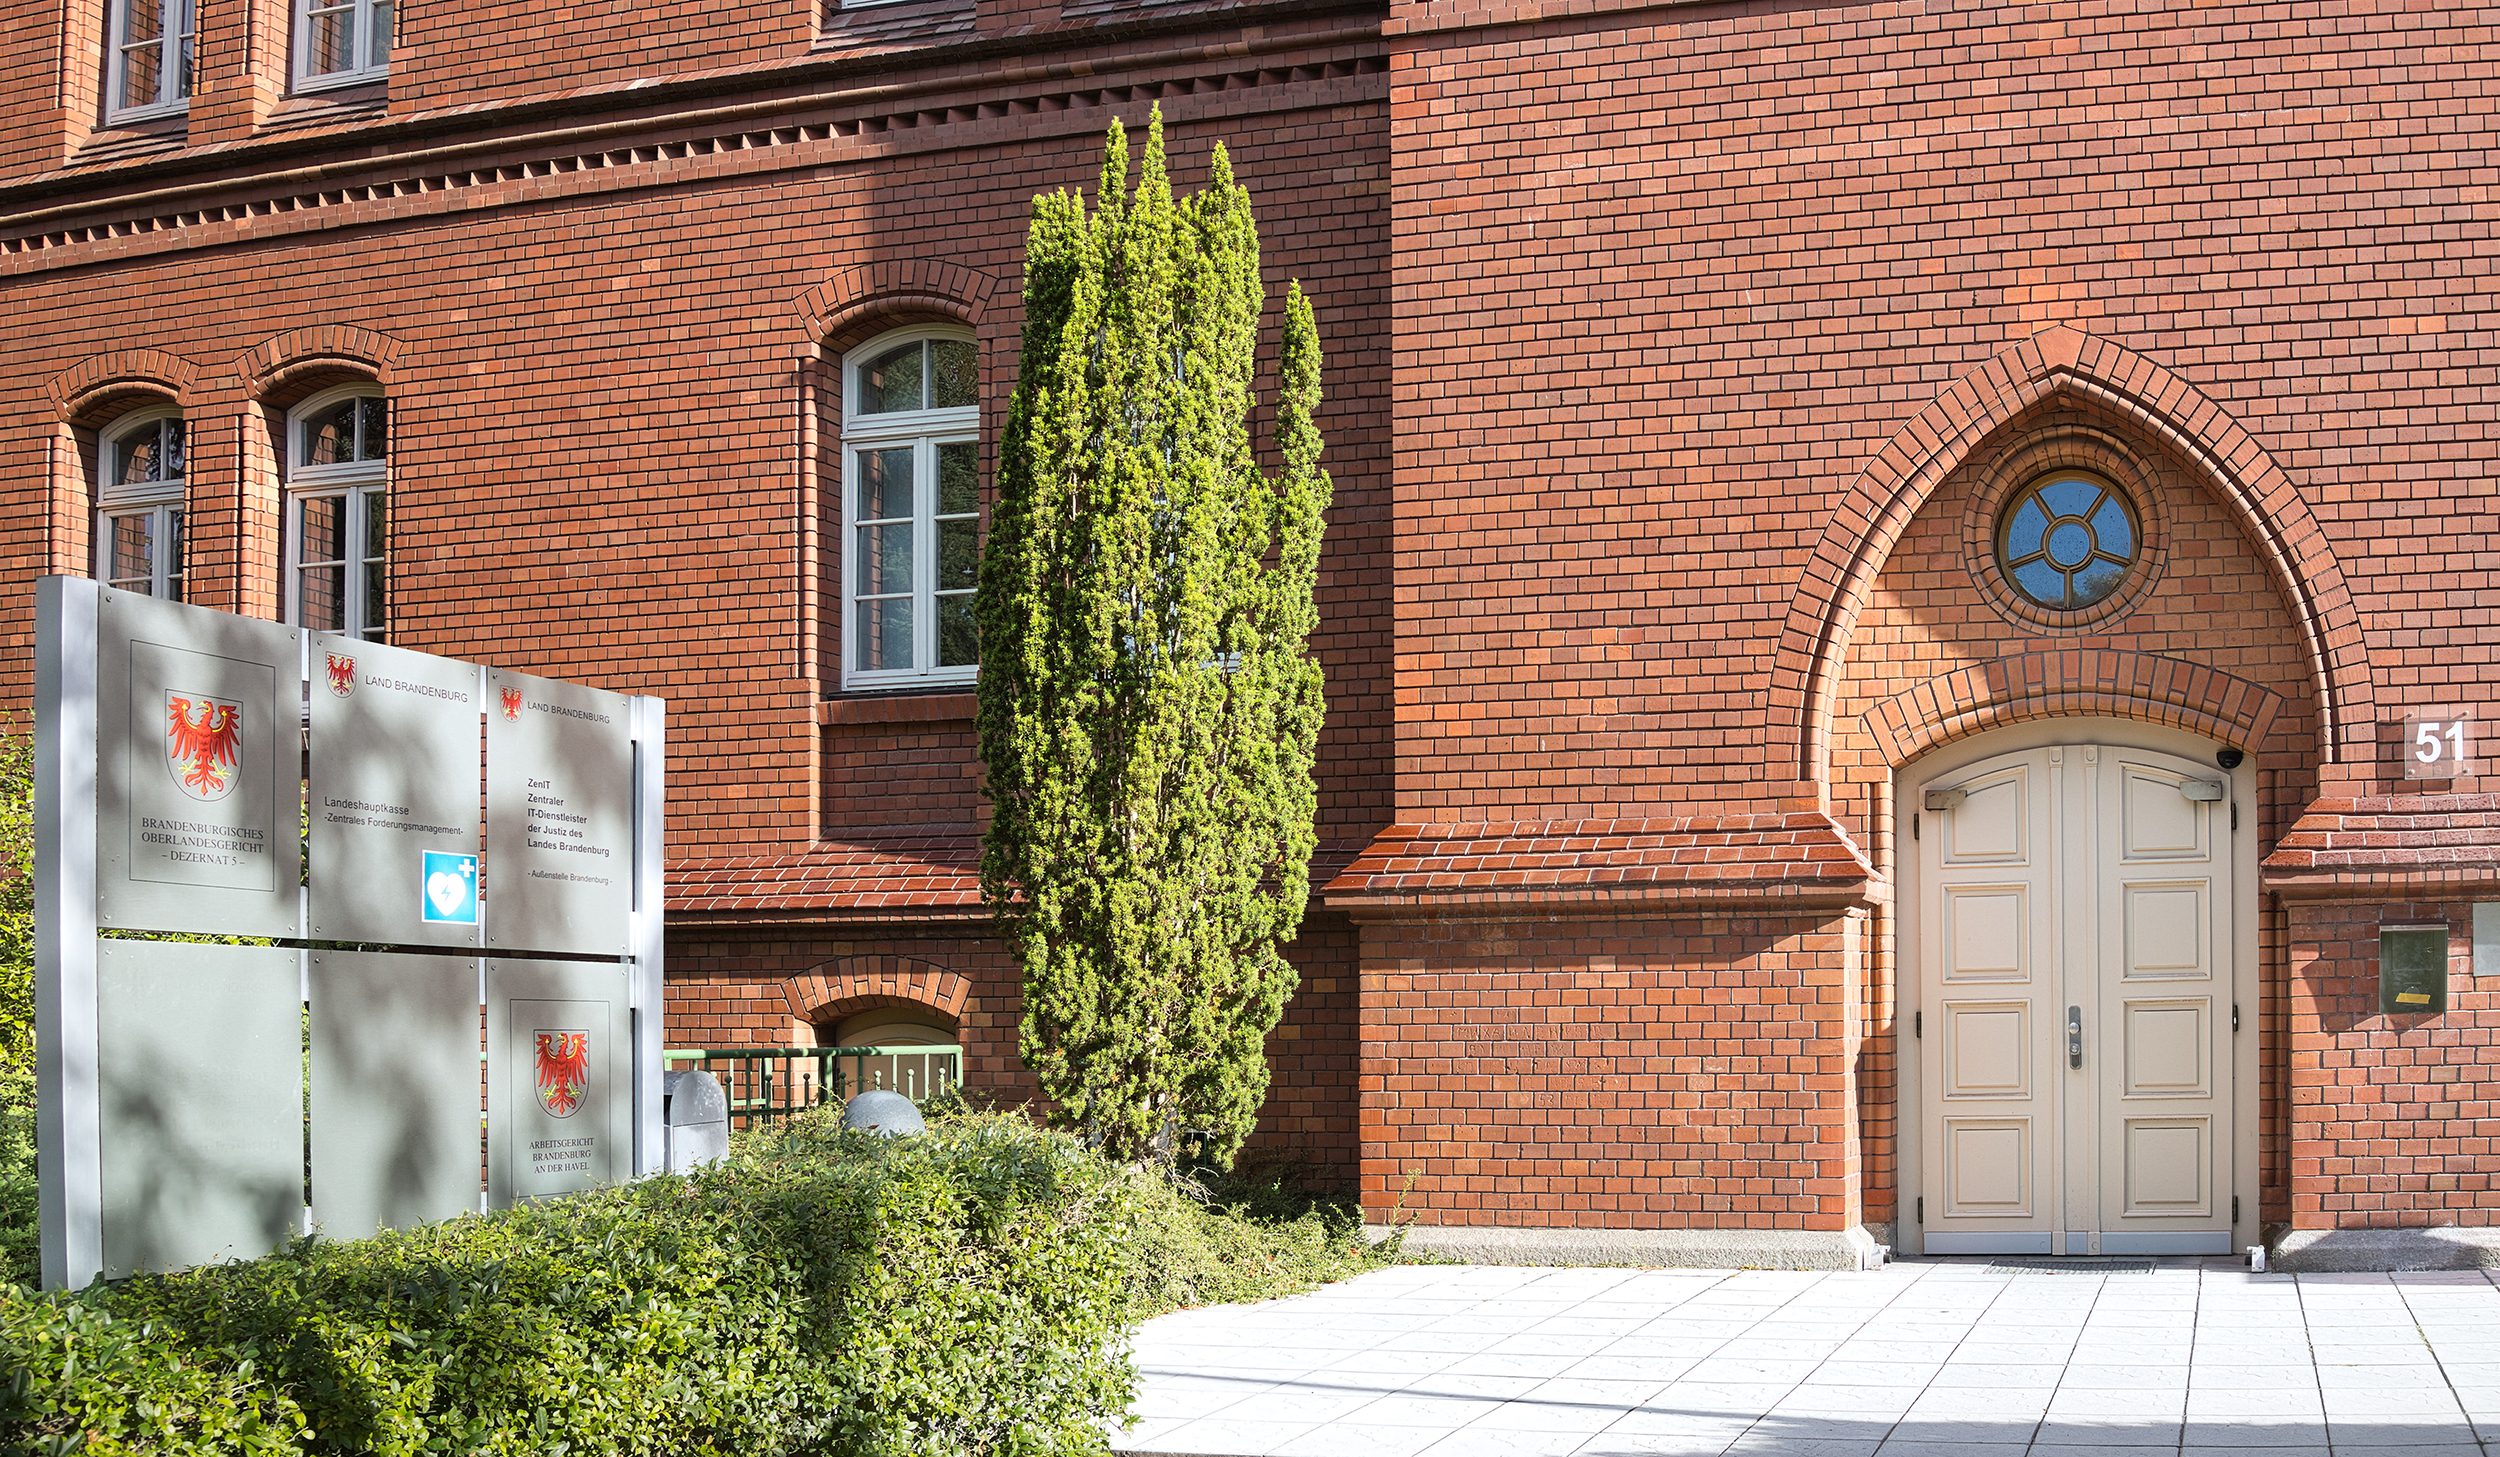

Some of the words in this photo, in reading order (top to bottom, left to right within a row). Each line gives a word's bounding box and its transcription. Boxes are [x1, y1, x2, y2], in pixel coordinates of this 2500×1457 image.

[365, 675, 392, 689] LAND
[394, 680, 468, 703] BRANDENBURG
[527, 701, 550, 713] LAND
[551, 705, 610, 724] BRANDENBURG
[2415, 721, 2464, 763] 51
[527, 778, 550, 790] ZenIT
[324, 796, 410, 816] Landeshauptkasse
[527, 793, 564, 806] Zentraler
[324, 812, 366, 826] -Zentrales
[368, 818, 464, 835] Forderungsmanagement-
[527, 808, 588, 824] IT-Dienstleister
[142, 818, 264, 840] BRANDENBURGISCHES
[527, 824, 541, 834] der
[543, 826, 567, 837] Justiz
[568, 828, 584, 838] des
[142, 832, 264, 854] OBERLANDESGERICHT
[527, 838, 558, 850] Landes
[559, 842, 610, 857] Brandenburg
[170, 851, 228, 866] DEZERNAT
[232, 856, 238, 866] 5
[531, 870, 568, 881] Außenstelle
[570, 873, 609, 886] Brandenburg
[529, 1138, 594, 1149] ARBEITSGERICHT
[532, 1150, 592, 1162] BRANDENBURG
[534, 1164, 546, 1174] AN
[548, 1164, 564, 1173] DER
[564, 1162, 590, 1172] HAVEL
